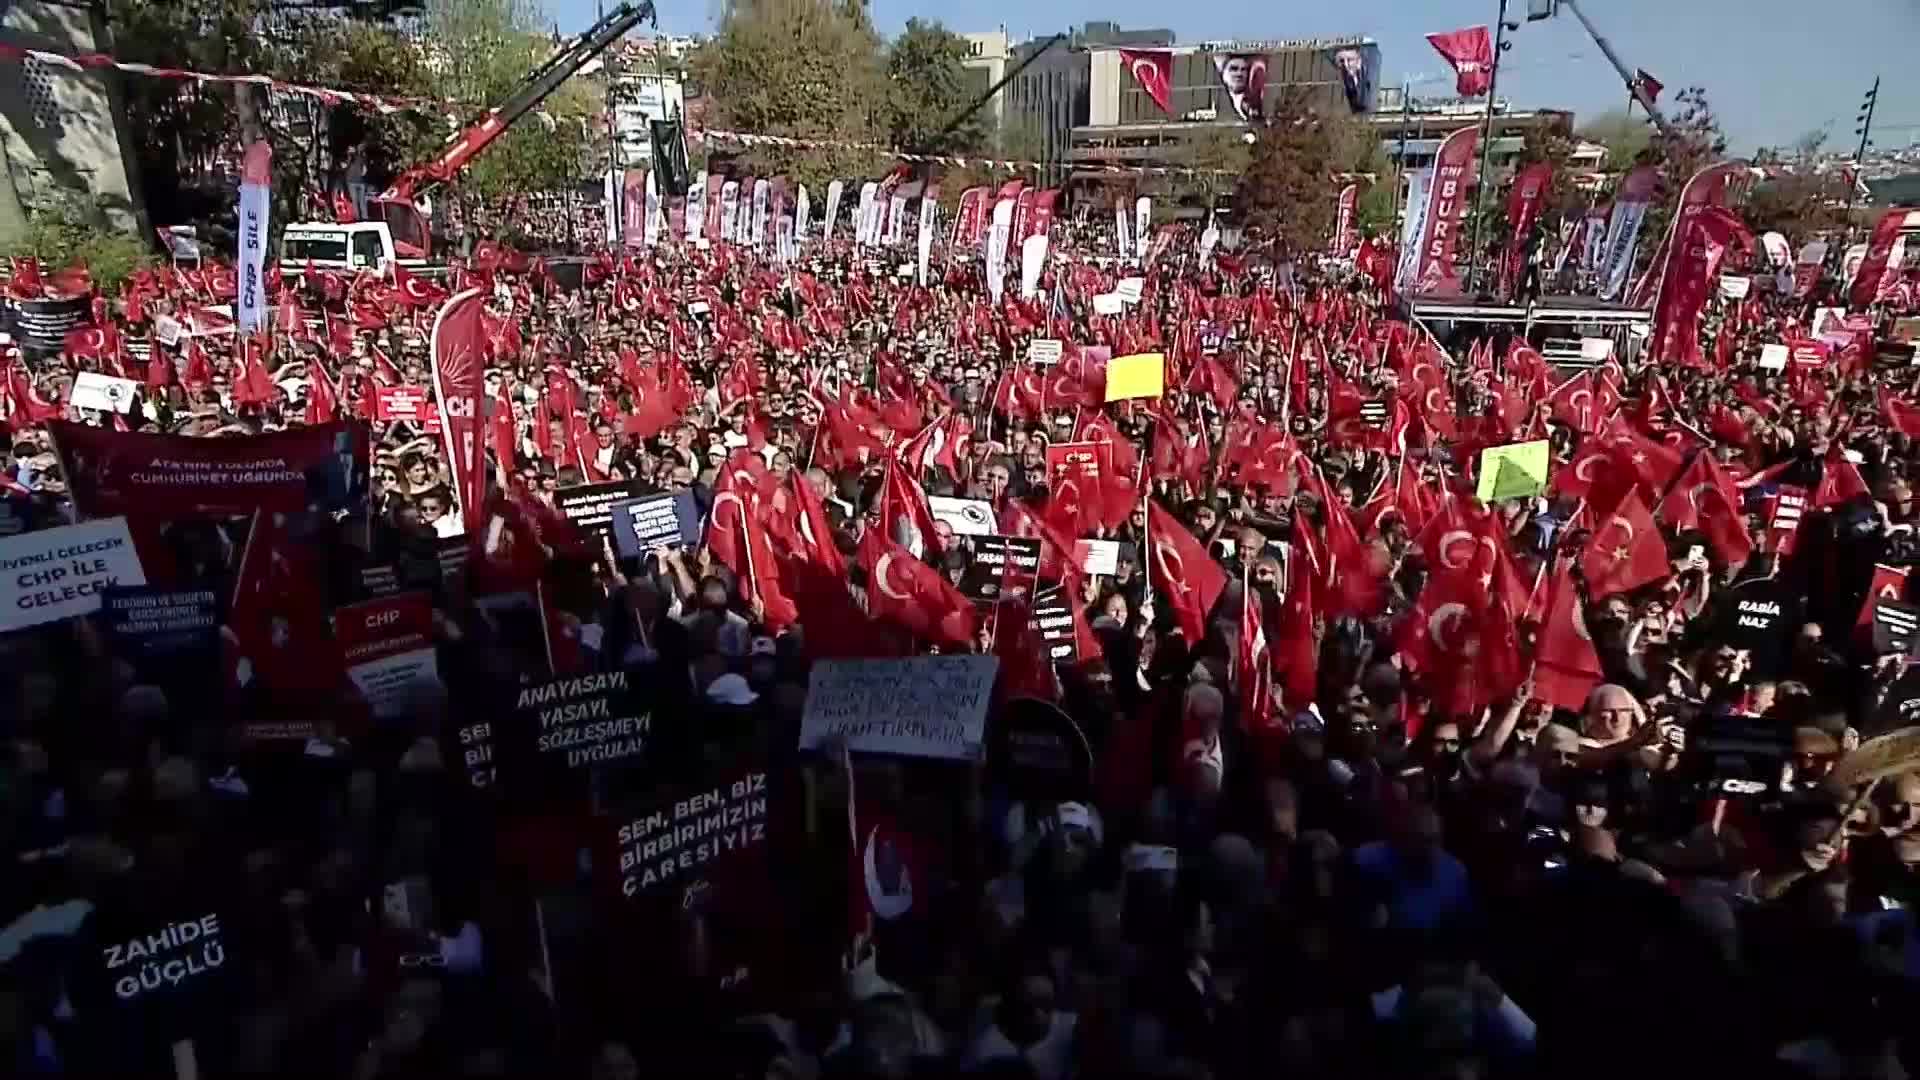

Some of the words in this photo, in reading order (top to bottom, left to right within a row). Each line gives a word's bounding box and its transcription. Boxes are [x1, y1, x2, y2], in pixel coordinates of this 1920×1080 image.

[1423, 180, 1458, 277] BURSA
[243, 263, 257, 309] CHP
[446, 395, 475, 417] CH
[57, 537, 124, 559] GELECEK
[16, 567, 68, 588] CHP
[71, 559, 108, 577] İLE
[16, 575, 120, 609] GELECEK
[1738, 600, 1780, 616] RABİA
[364, 609, 401, 629] CHP
[1738, 615, 1771, 629] NAZ
[516, 671, 629, 710] ANAYASAYI,
[538, 698, 611, 730] YASAYI,
[617, 810, 670, 847] SEN,
[674, 787, 727, 821] BEN,
[731, 770, 768, 800] BİZ
[618, 796, 768, 875] BİRBİRİMİZİN
[620, 822, 767, 905] ÇARESİYİZ
[103, 911, 222, 969] ZAHİDE
[114, 937, 226, 1001] GÜÇLÜ
